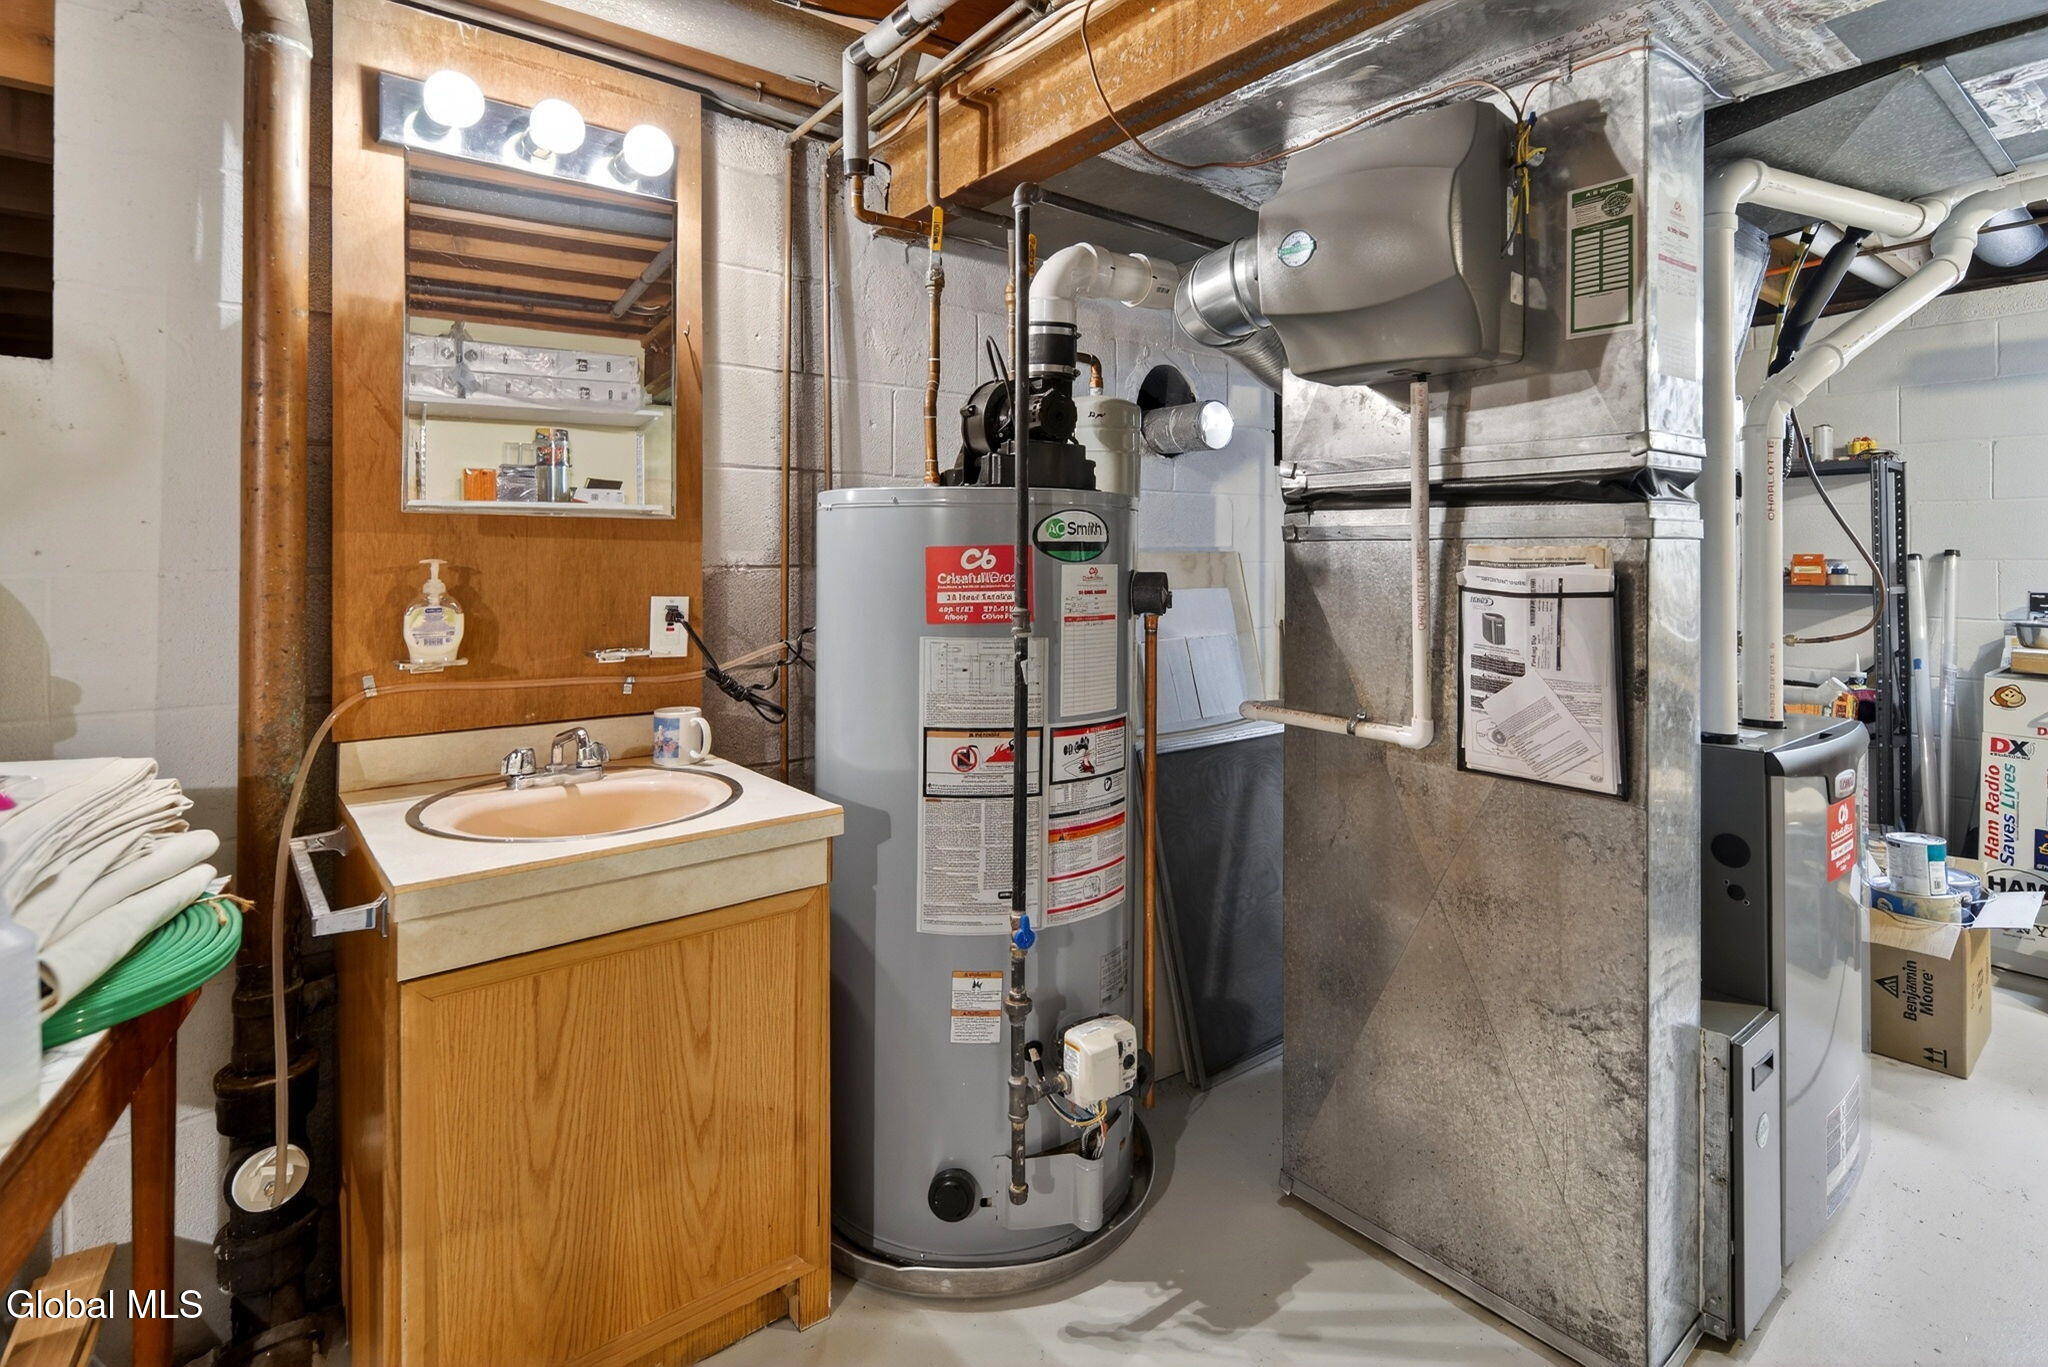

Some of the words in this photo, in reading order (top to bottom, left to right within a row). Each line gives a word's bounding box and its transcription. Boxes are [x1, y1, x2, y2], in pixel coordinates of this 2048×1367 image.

[1067, 521, 1102, 536] Smith
[1990, 737, 2029, 758] DX
[1985, 764, 2000, 815] Radio
[2001, 763, 2016, 810] Lives
[1984, 819, 2000, 860] Ham
[2000, 813, 2016, 866] Saves
[1903, 960, 1920, 1021] Benjamin
